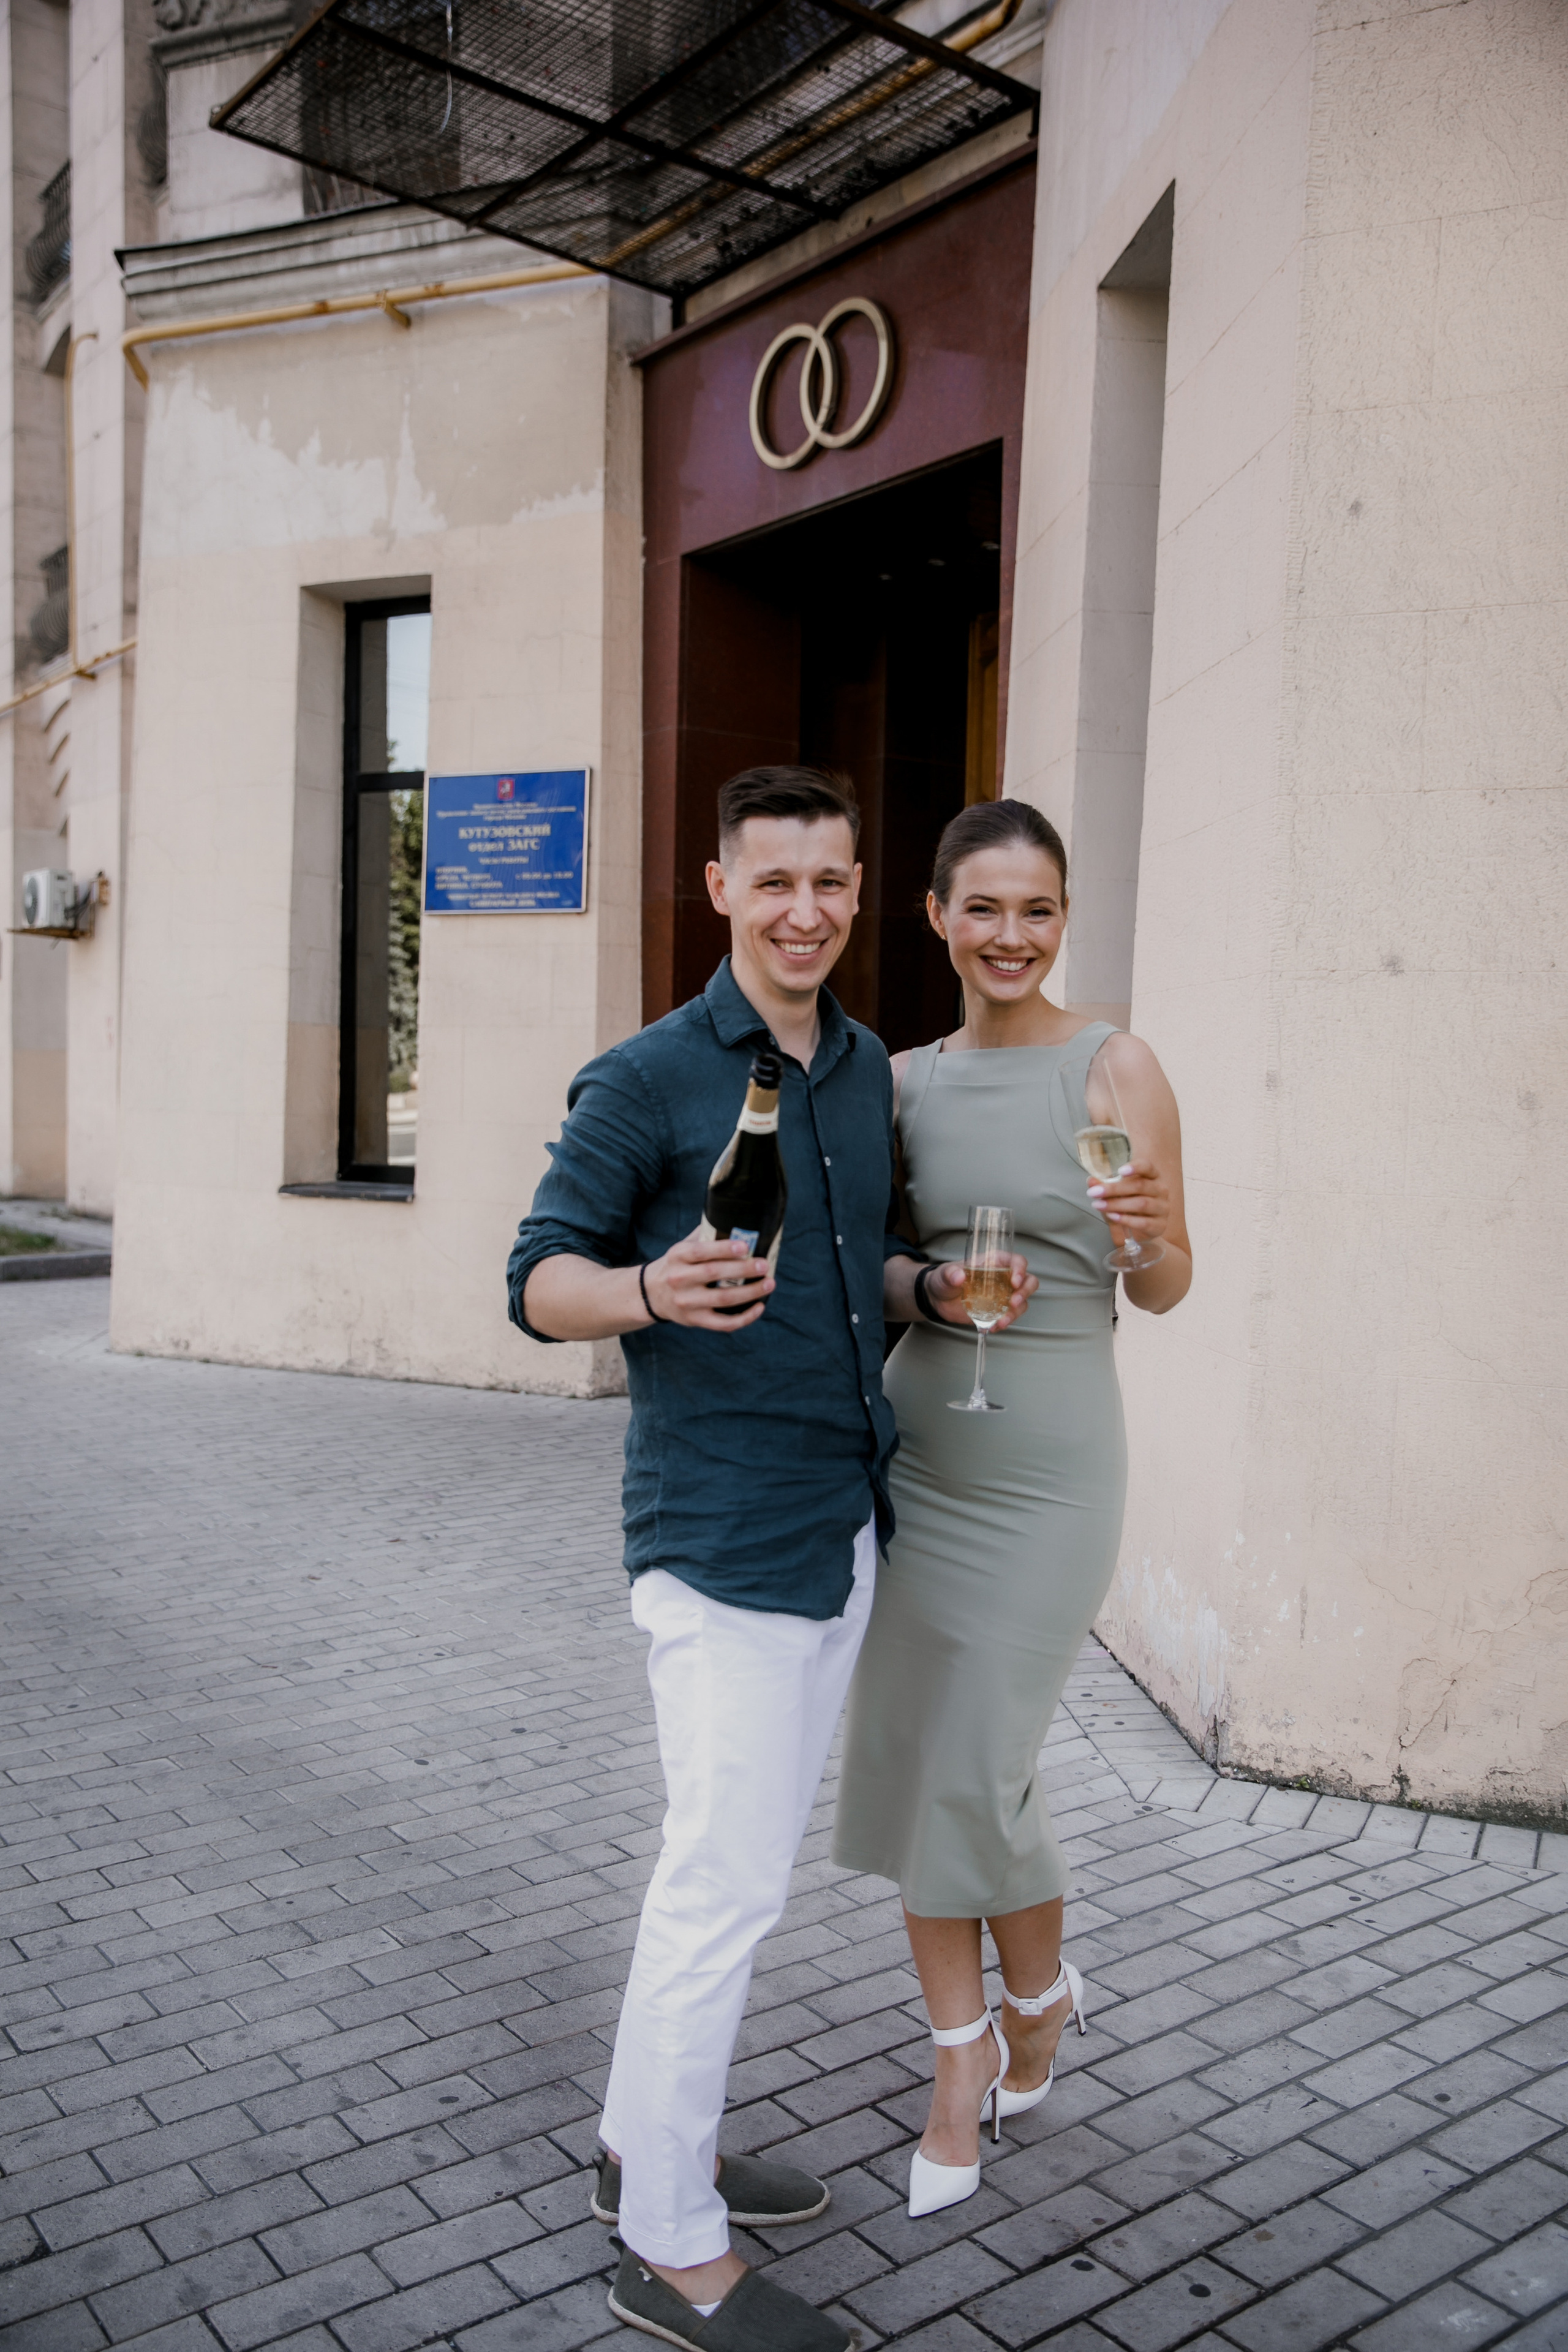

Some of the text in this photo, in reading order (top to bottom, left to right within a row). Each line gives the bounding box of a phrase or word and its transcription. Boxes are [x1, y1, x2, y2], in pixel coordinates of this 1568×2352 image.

[458, 823, 551, 839] КУТУЗОВСКИЙ
[468, 838, 540, 853] отдел ЗАГС
